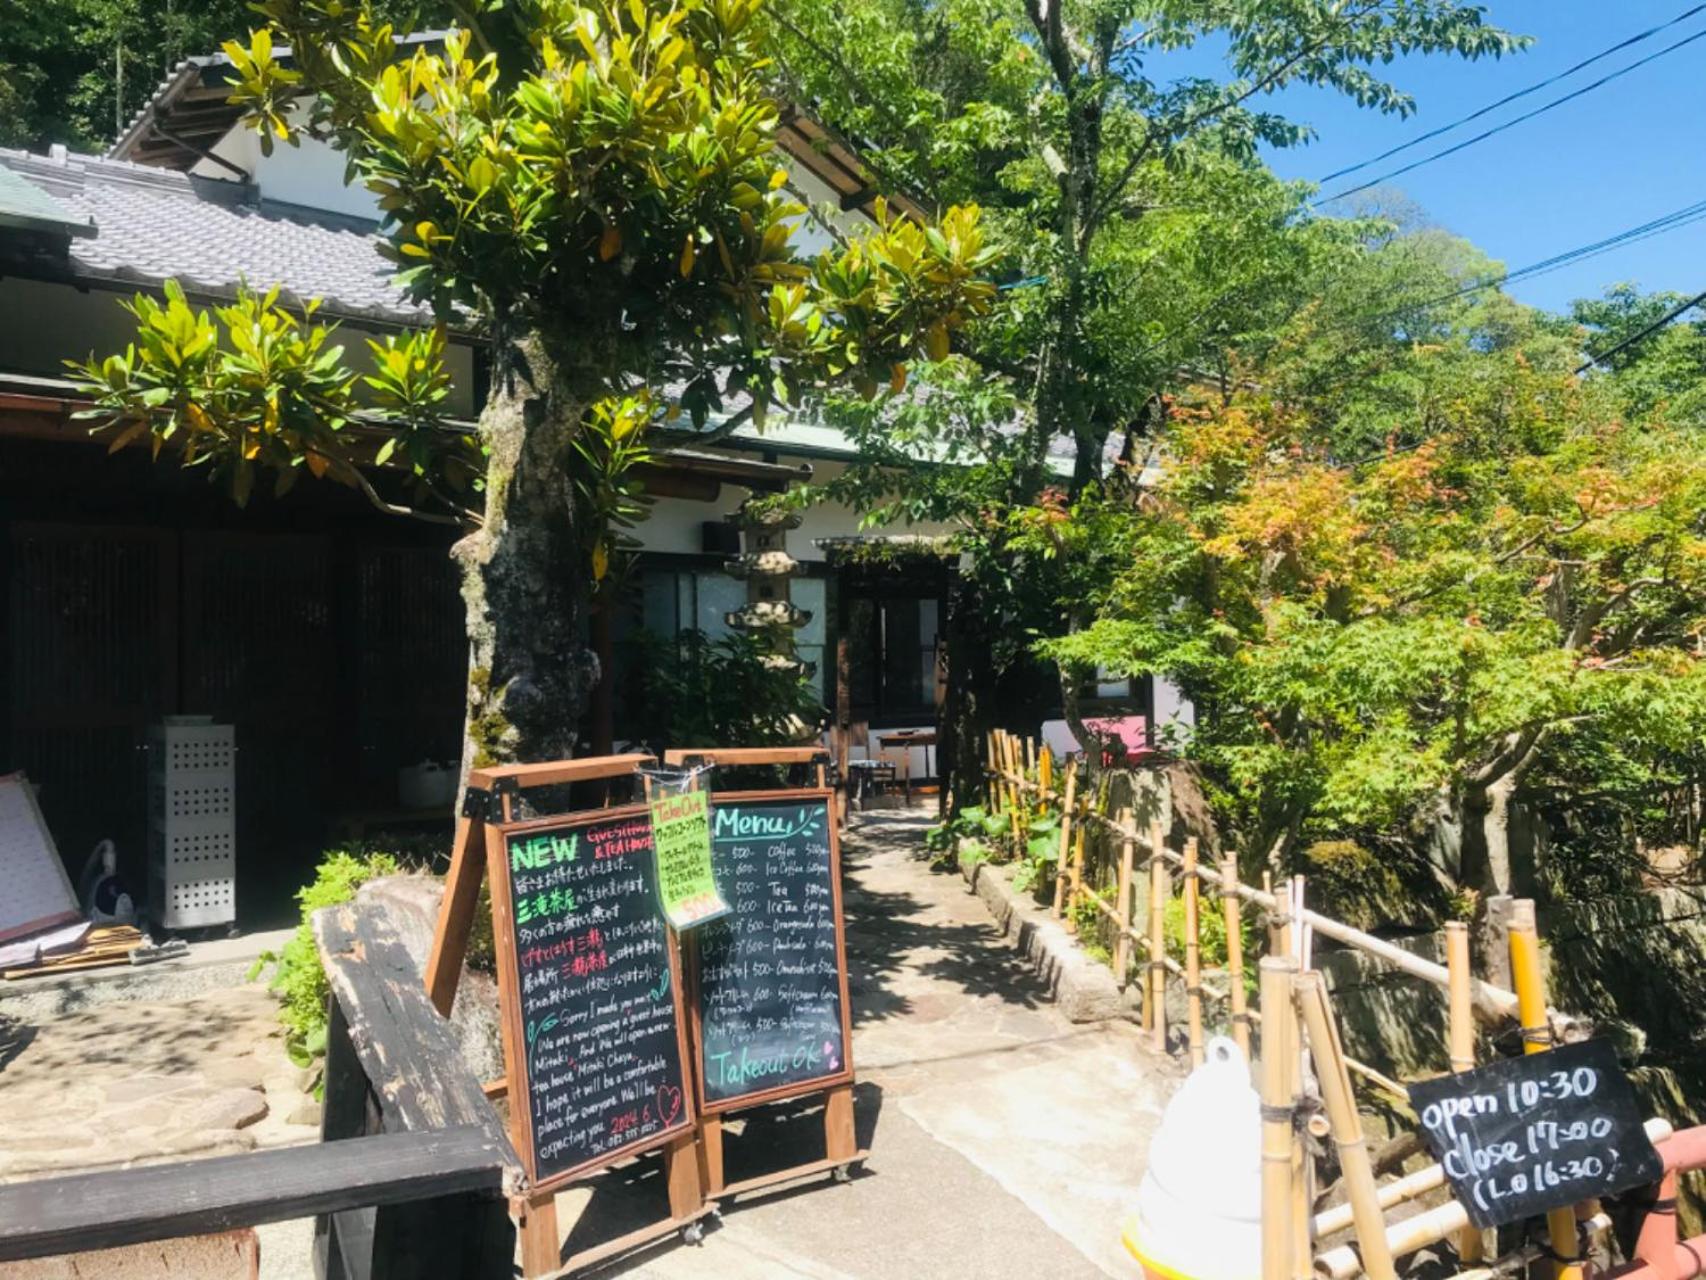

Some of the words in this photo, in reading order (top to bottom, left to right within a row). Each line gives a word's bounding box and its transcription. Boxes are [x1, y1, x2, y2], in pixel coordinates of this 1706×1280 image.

[715, 808, 786, 837] Menu
[511, 833, 579, 872] NEW
[768, 881, 788, 896] Tea
[551, 1070, 574, 1088] house
[710, 1046, 788, 1085] Takeout
[546, 1093, 569, 1112] hope
[572, 1087, 581, 1100] it
[584, 1077, 600, 1096] will
[604, 1072, 615, 1088] be
[1507, 1066, 1598, 1114] 10:30
[540, 1129, 587, 1159] expecting
